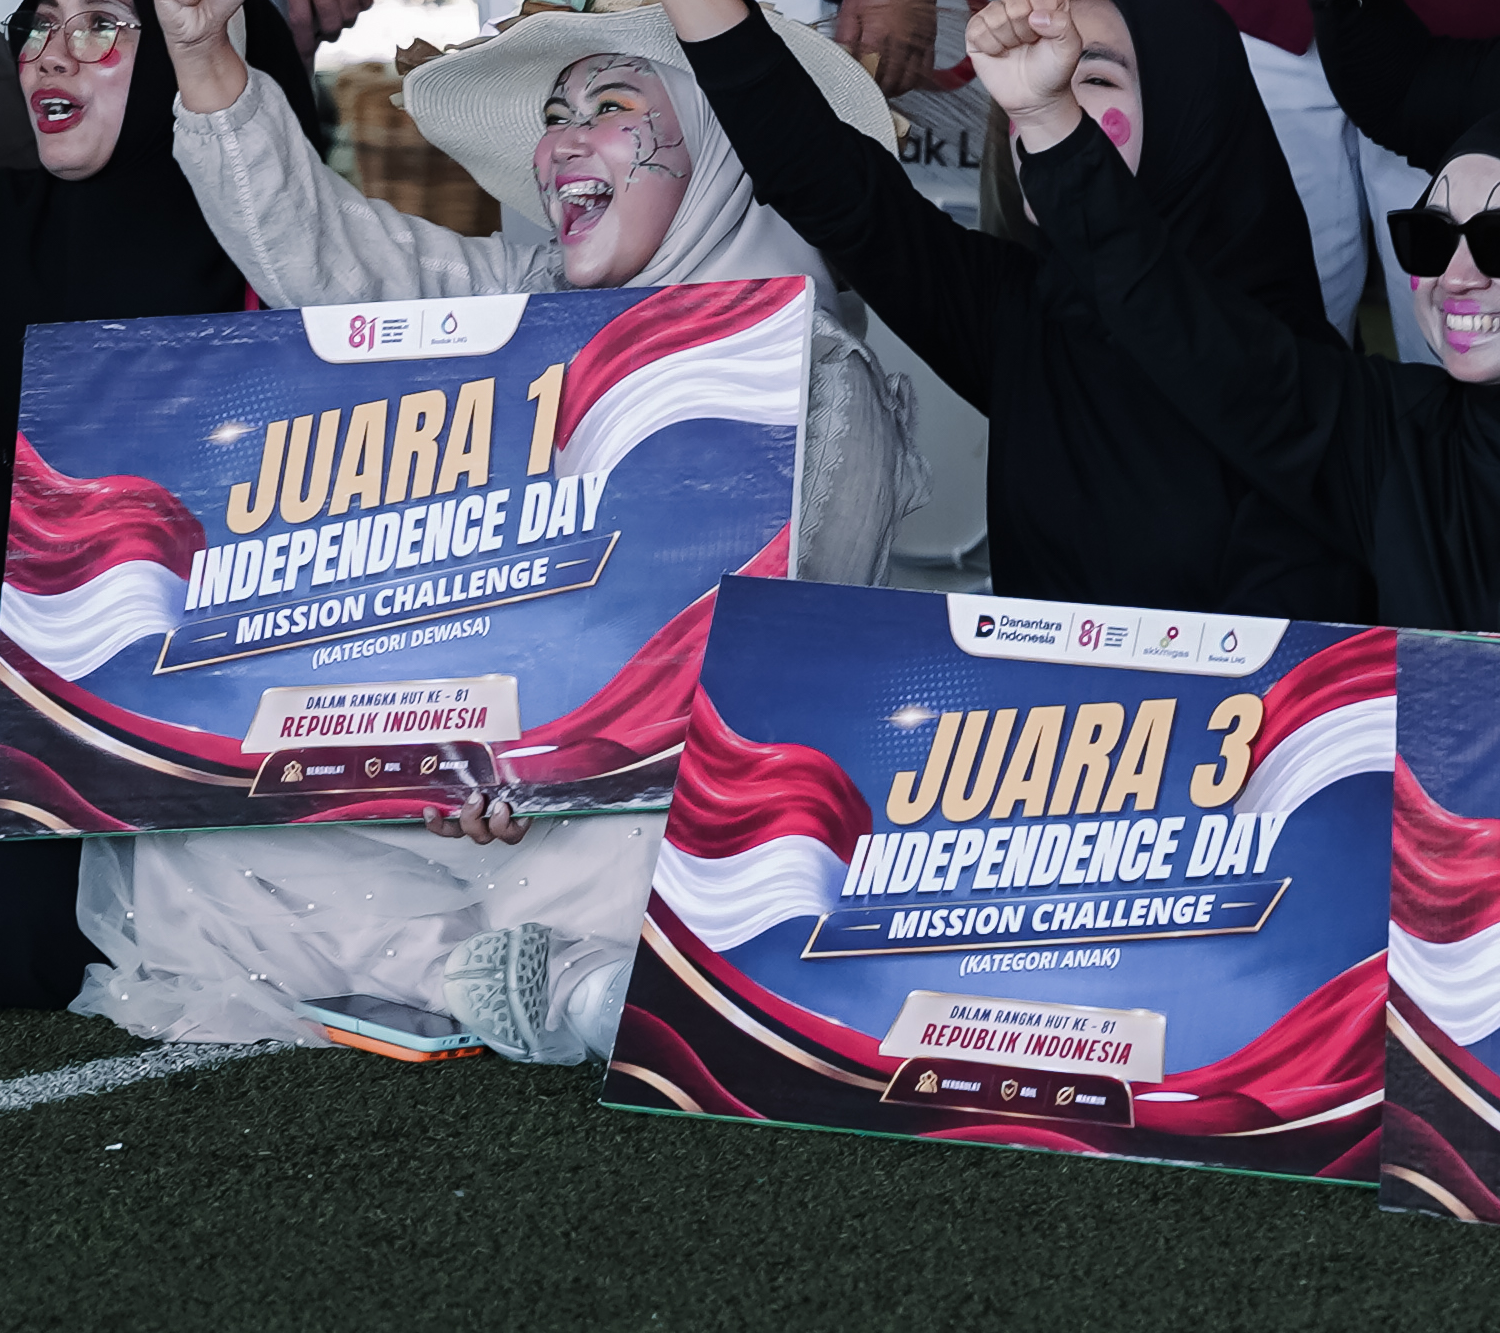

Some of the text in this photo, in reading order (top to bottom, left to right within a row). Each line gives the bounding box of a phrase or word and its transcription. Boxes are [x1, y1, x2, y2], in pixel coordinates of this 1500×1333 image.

[349, 315, 380, 353] 81
[226, 363, 567, 534] JUARA 1
[185, 469, 611, 612] INDEPENDENCE DAY
[235, 557, 549, 646] MISSION CHALLENGE
[311, 616, 491, 670] (KATEGORI DEWASA)
[996, 629, 1056, 645] Indonesia
[1000, 615, 1062, 632] Danantara
[1078, 619, 1106, 651] 81
[305, 695, 346, 710] DALAM
[349, 692, 396, 708] RANGKA
[400, 690, 424, 705] HUT
[426, 689, 443, 703] KE
[454, 688, 470, 702] 81
[280, 706, 488, 738] REPUBLIK INDONESIA
[886, 692, 1265, 826] JUARA 3
[841, 810, 1290, 898] INDEPENDENCE DAY
[888, 894, 1214, 941] MISSION CHALLENGE
[958, 947, 1121, 977] (KATEGORI ANAK)
[949, 1005, 992, 1022] DALAM
[994, 1009, 1042, 1028] RANGKA
[1045, 1014, 1070, 1030] HUT
[1072, 1017, 1089, 1032] KE
[1100, 1020, 1117, 1034] 81
[920, 1023, 1133, 1066] REPUBLIK INDONESIA
